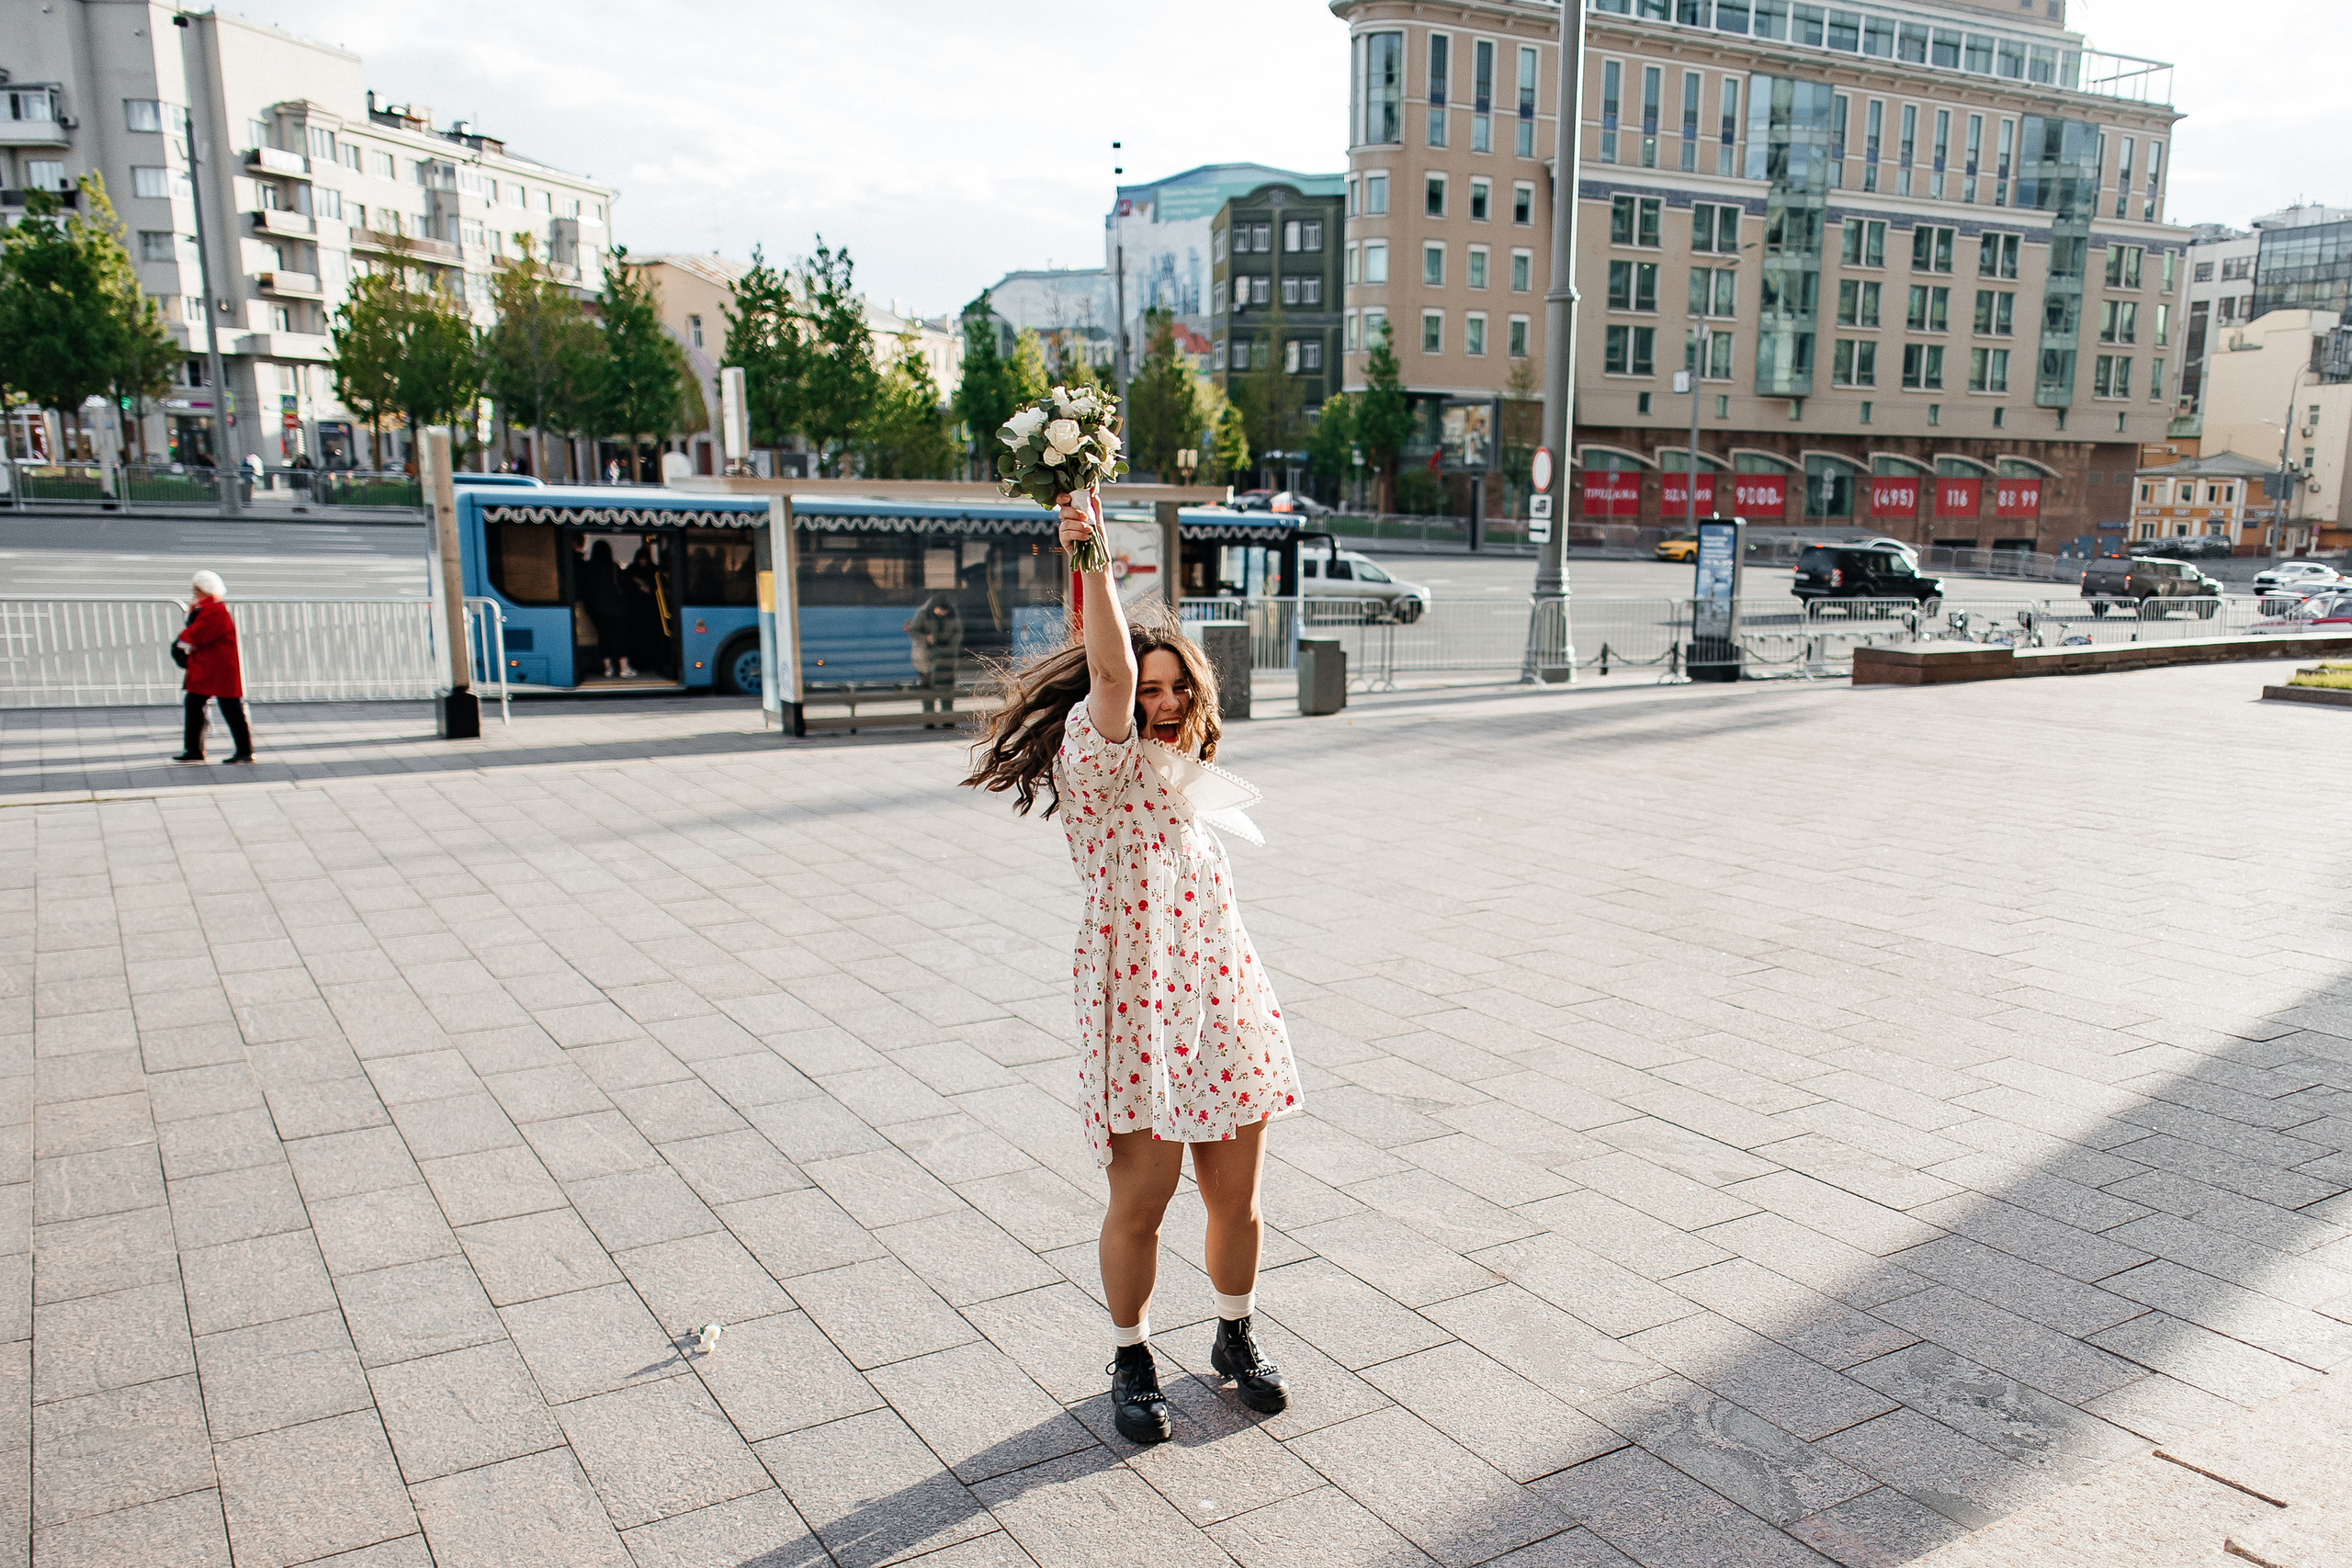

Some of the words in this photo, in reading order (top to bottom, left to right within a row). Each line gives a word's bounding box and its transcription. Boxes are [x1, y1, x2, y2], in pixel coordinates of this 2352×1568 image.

[1663, 488, 1712, 502] ЗДАИЯ
[1873, 487, 1915, 508] (495)
[1947, 489, 1968, 507] 116
[2021, 490, 2038, 507] 99
